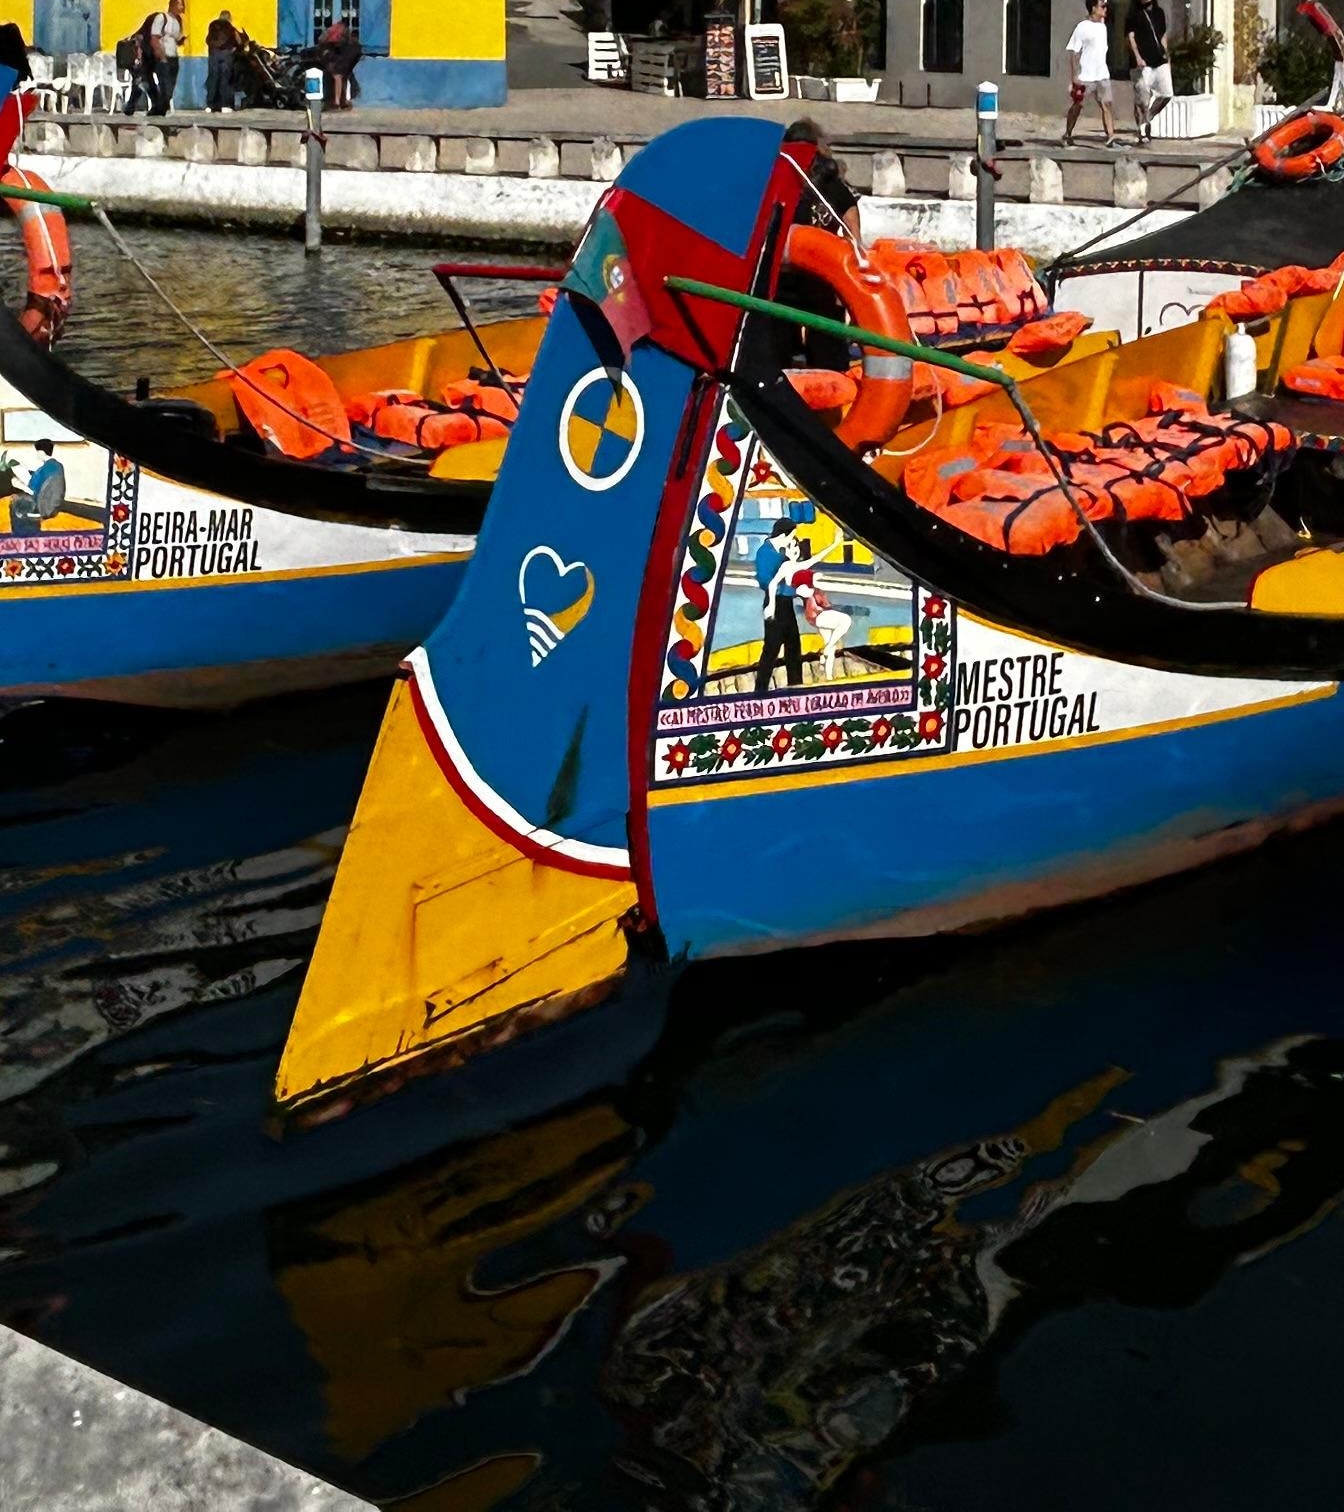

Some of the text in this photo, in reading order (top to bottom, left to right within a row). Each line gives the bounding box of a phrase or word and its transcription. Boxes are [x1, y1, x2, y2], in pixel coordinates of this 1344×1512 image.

[138, 508, 254, 545] BEIRA-MAR
[135, 540, 262, 579] PORTUGAL
[956, 651, 1064, 706] MESTRE
[952, 691, 1100, 751] PORTUGAL
